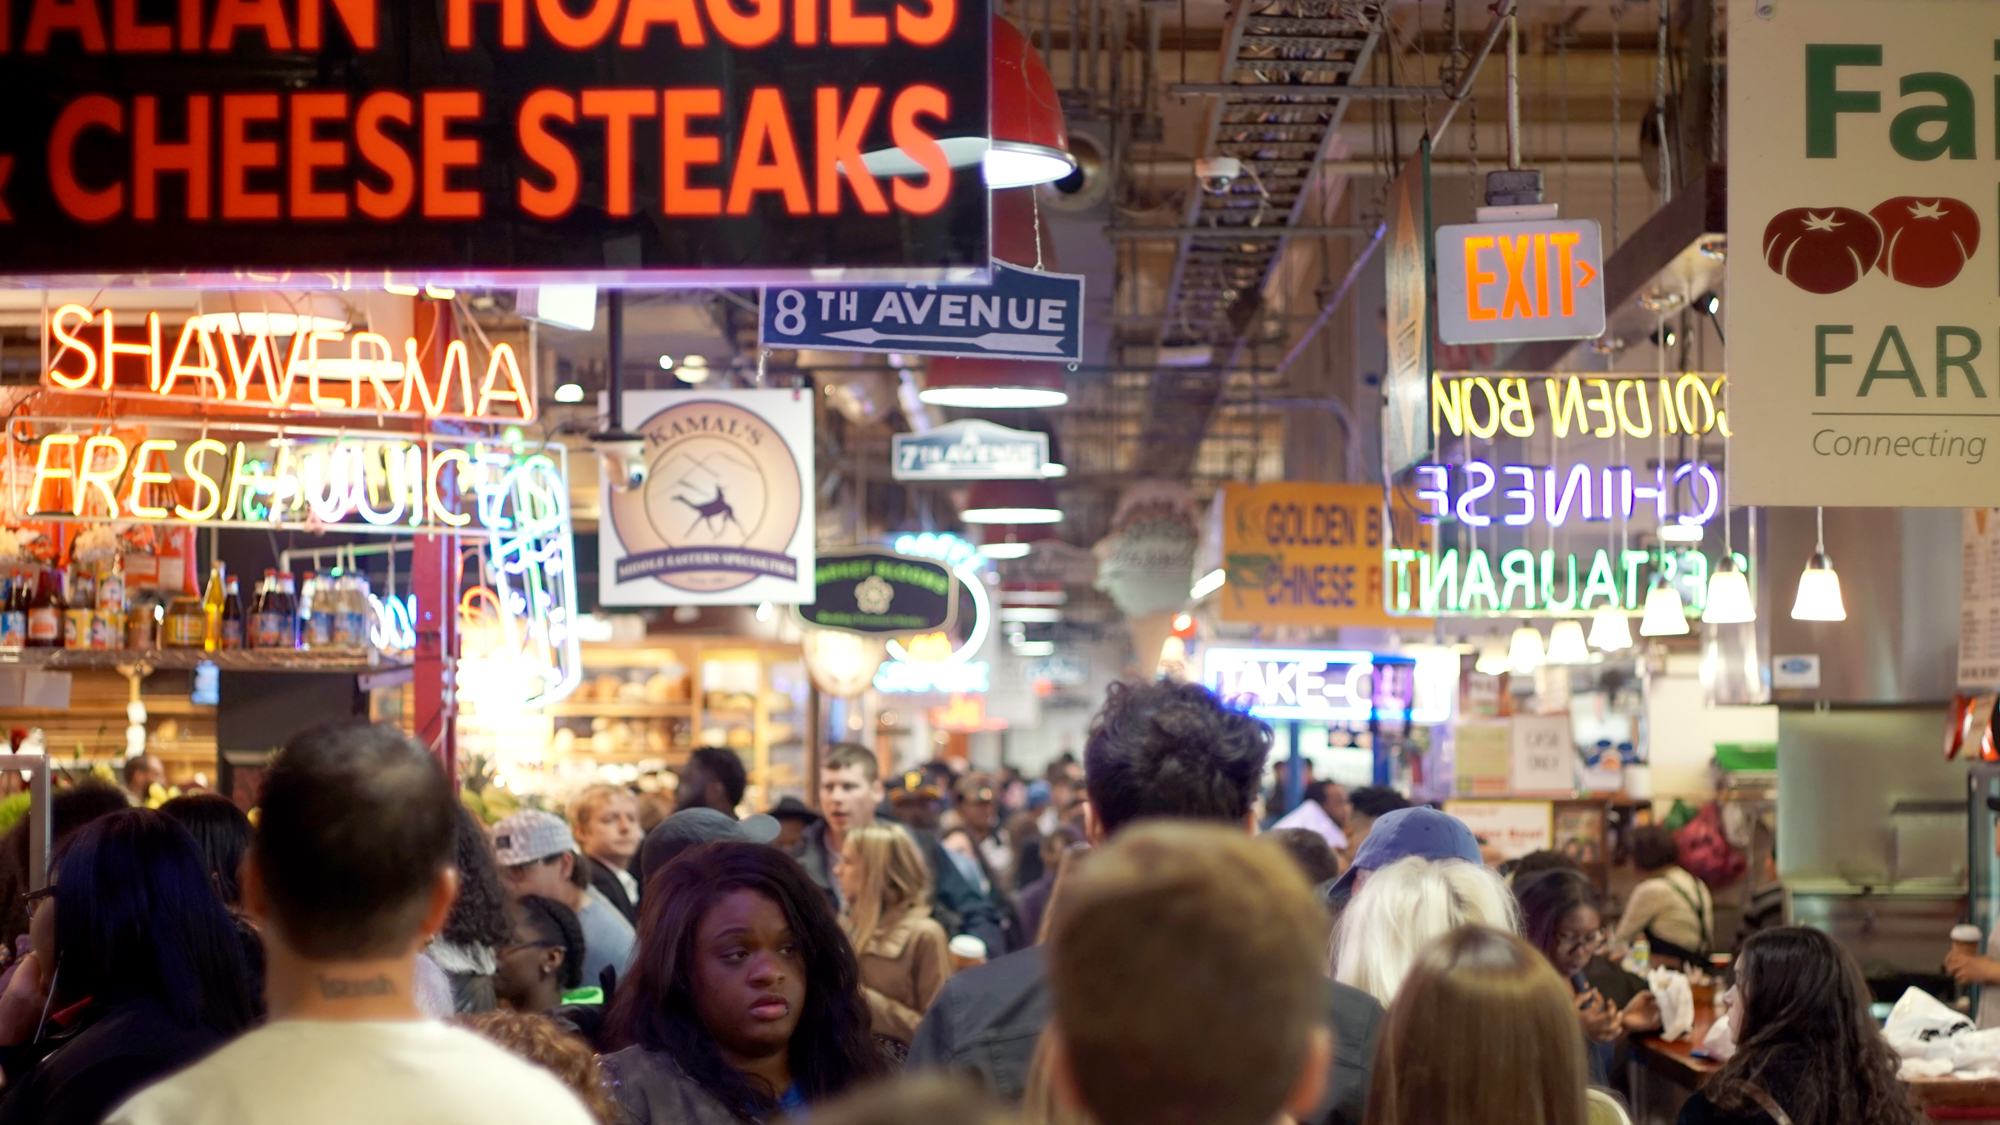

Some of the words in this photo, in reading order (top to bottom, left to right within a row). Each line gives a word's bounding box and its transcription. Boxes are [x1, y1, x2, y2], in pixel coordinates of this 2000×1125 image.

[1805, 38, 2000, 161] Fa
[47, 91, 481, 223] CHEESE
[518, 85, 952, 219] STEAKS
[1464, 232, 1580, 322] EXIT
[872, 291, 1067, 331] AVENUE
[50, 304, 533, 421] SHAWERMA
[1815, 325, 2000, 398] FAR
[649, 414, 765, 448] KAMAL'S
[1812, 429, 1987, 465] Connecting
[28, 434, 291, 522] FRESH
[1265, 502, 1357, 546] GOLDEN
[618, 555, 664, 578] MIDDLE
[666, 551, 720, 568] EASTERN
[1263, 564, 1356, 607] CHINESE
